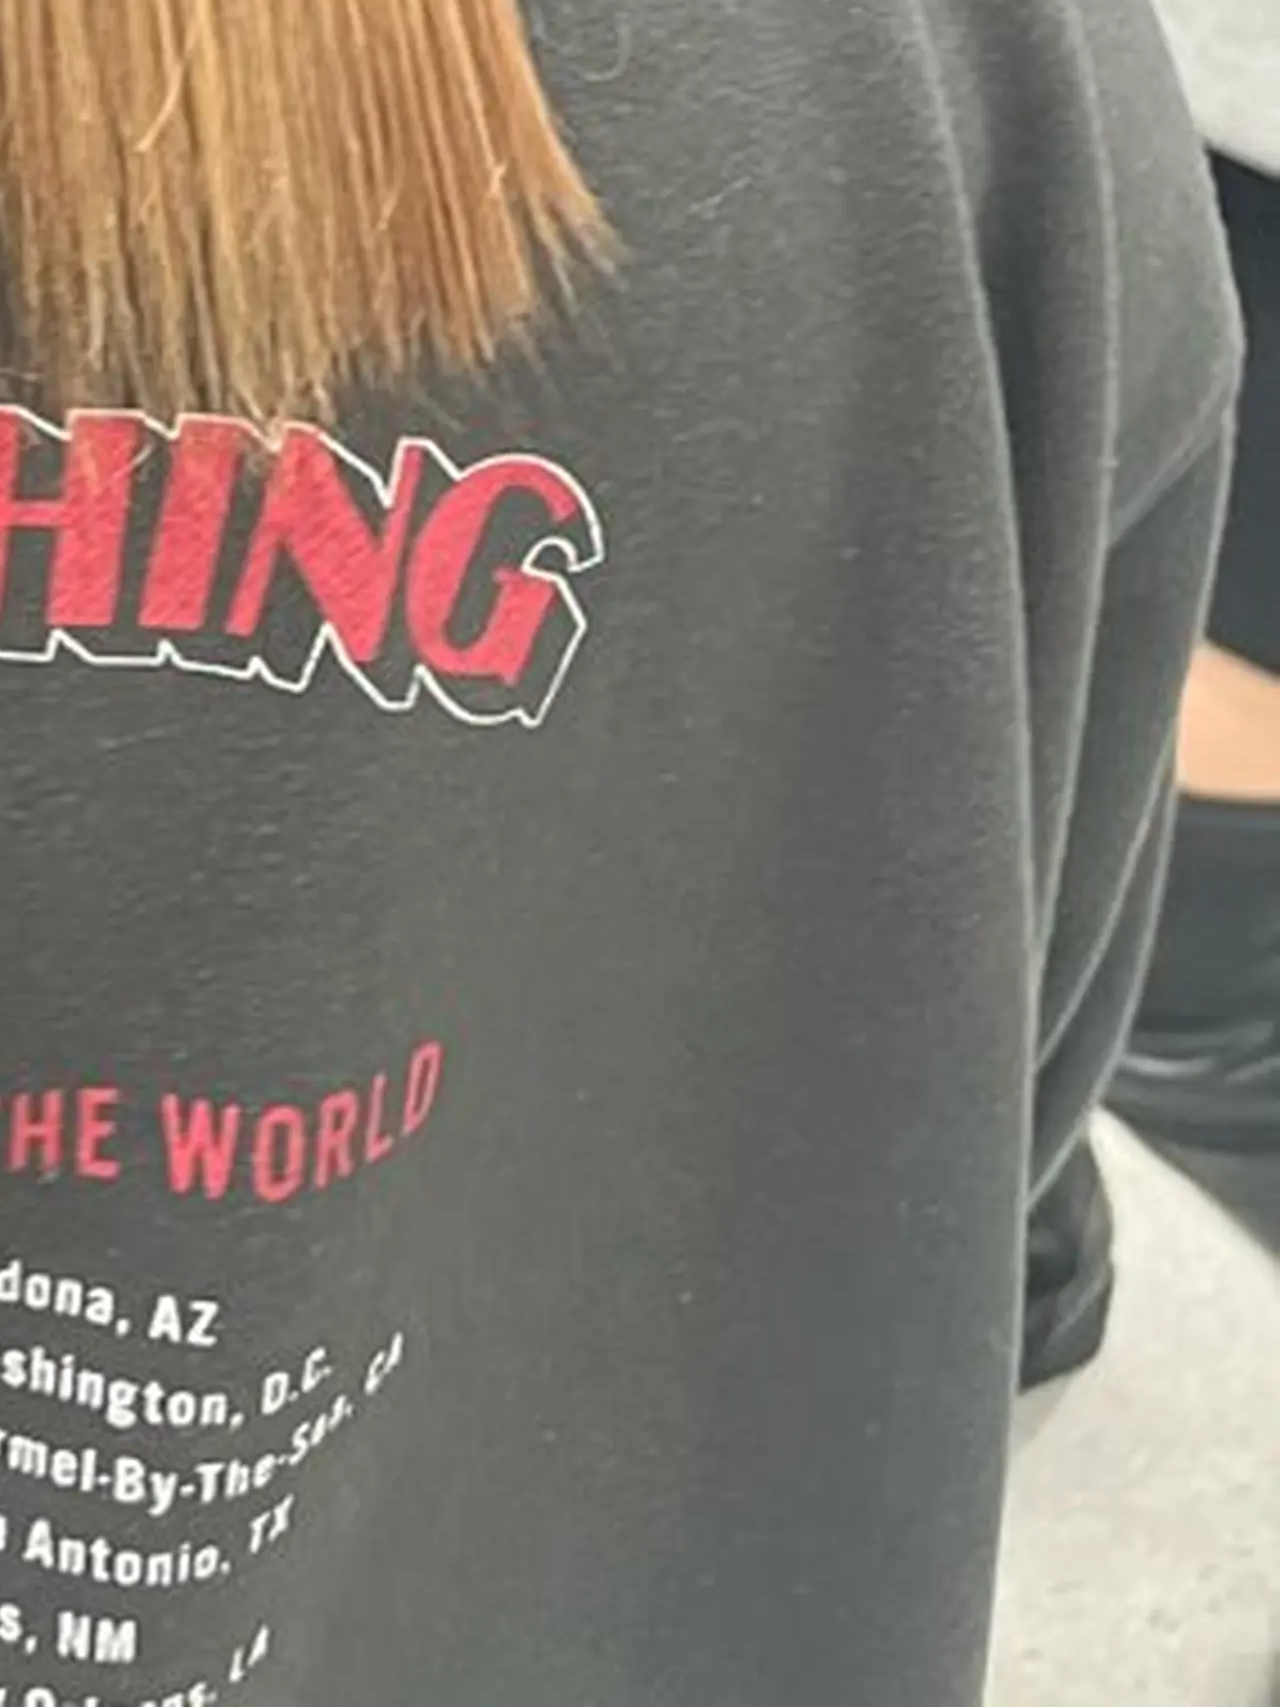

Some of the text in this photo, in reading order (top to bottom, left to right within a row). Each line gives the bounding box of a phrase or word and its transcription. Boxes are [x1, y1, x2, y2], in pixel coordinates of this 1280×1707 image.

[159, 1039, 443, 1204] WORLD
[148, 1295, 220, 1347] AZ
[57, 1610, 138, 1664] NM
